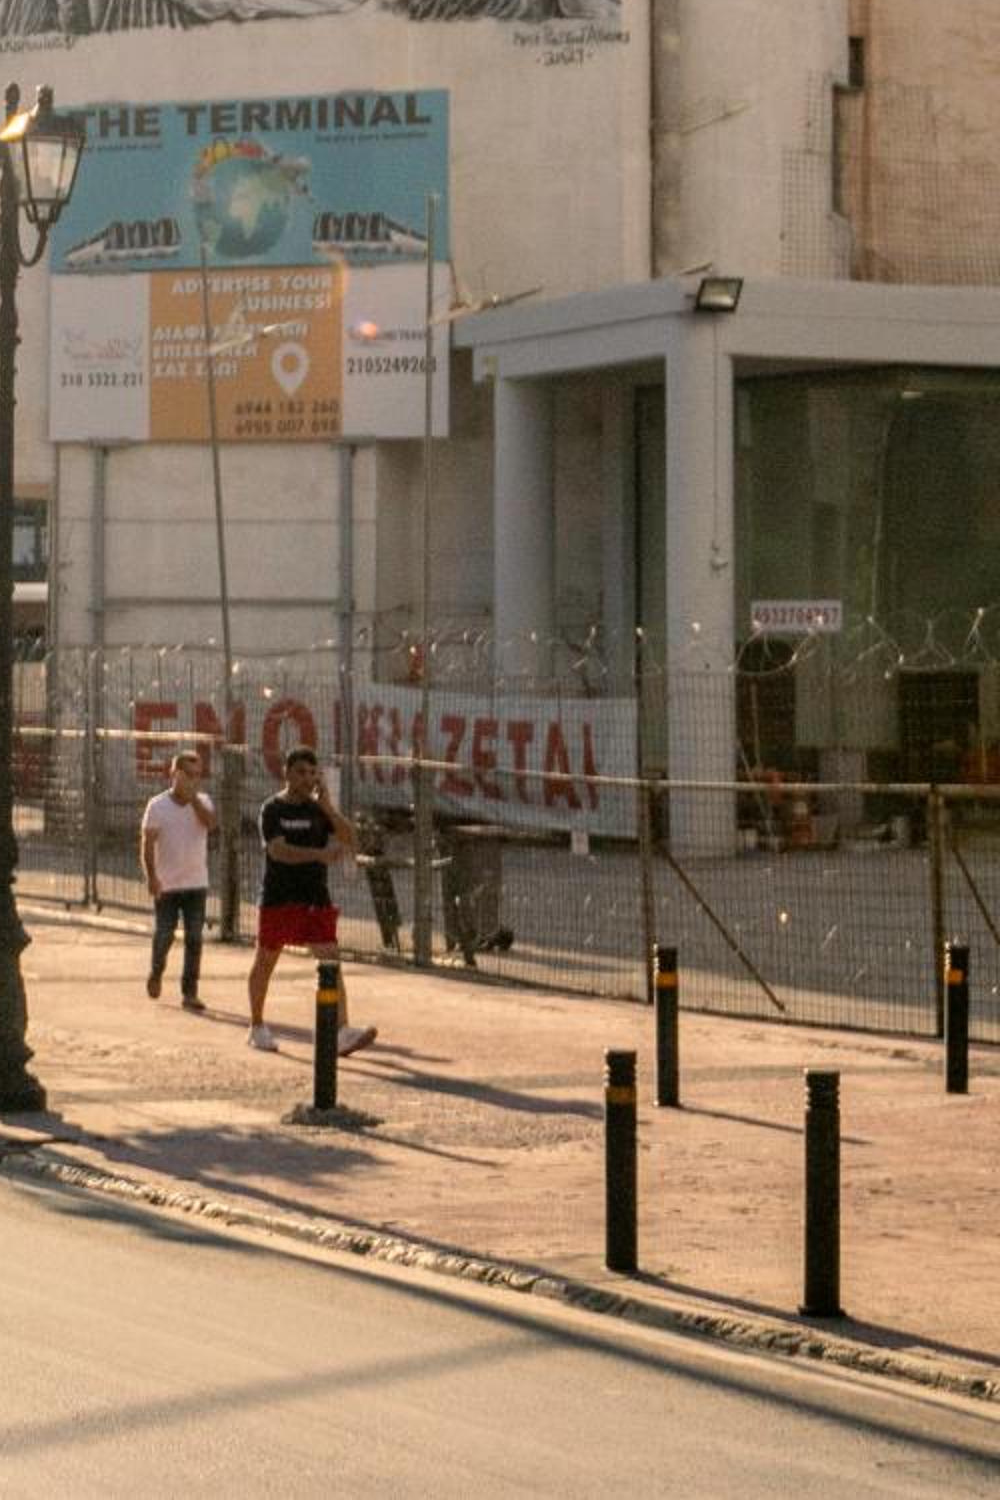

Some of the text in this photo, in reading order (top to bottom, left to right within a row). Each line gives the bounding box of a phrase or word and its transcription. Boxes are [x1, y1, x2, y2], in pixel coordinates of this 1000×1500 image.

[67, 93, 432, 137] THE TERMINAL
[172, 274, 332, 293] ADVERTISE YOUR
[240, 293, 332, 309] USINESS!
